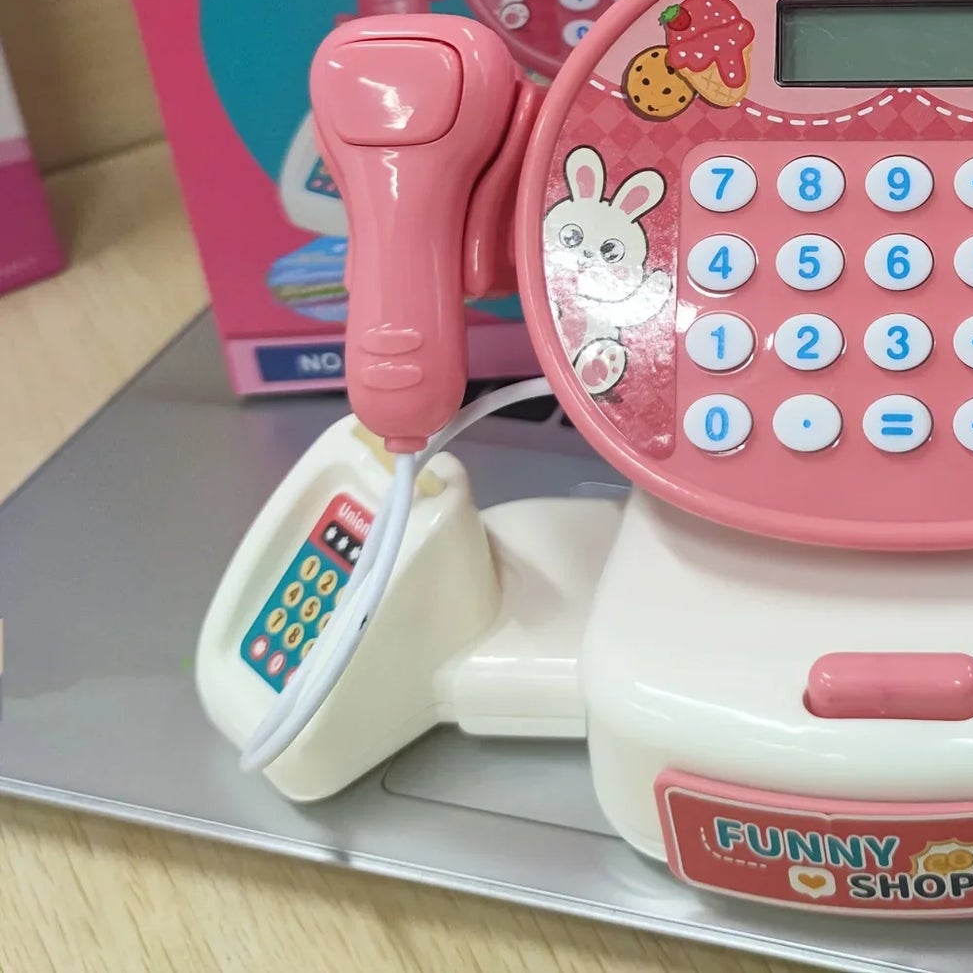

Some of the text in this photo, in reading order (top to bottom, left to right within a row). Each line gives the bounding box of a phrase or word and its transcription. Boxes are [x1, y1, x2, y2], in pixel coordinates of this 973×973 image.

[711, 168, 735, 200] 7
[799, 167, 822, 201] 8
[887, 167, 911, 201] 9
[708, 246, 732, 280] 4
[798, 246, 821, 279] 5
[887, 246, 911, 279] 6
[710, 327, 726, 360] 1
[796, 326, 819, 360] 2
[886, 326, 910, 360] 3
[705, 407, 730, 441] 0
[306, 560, 332, 590] 1 2
[288, 587, 318, 617] 4 5
[271, 614, 301, 645] 7 8
[714, 816, 898, 869] FUNNY
